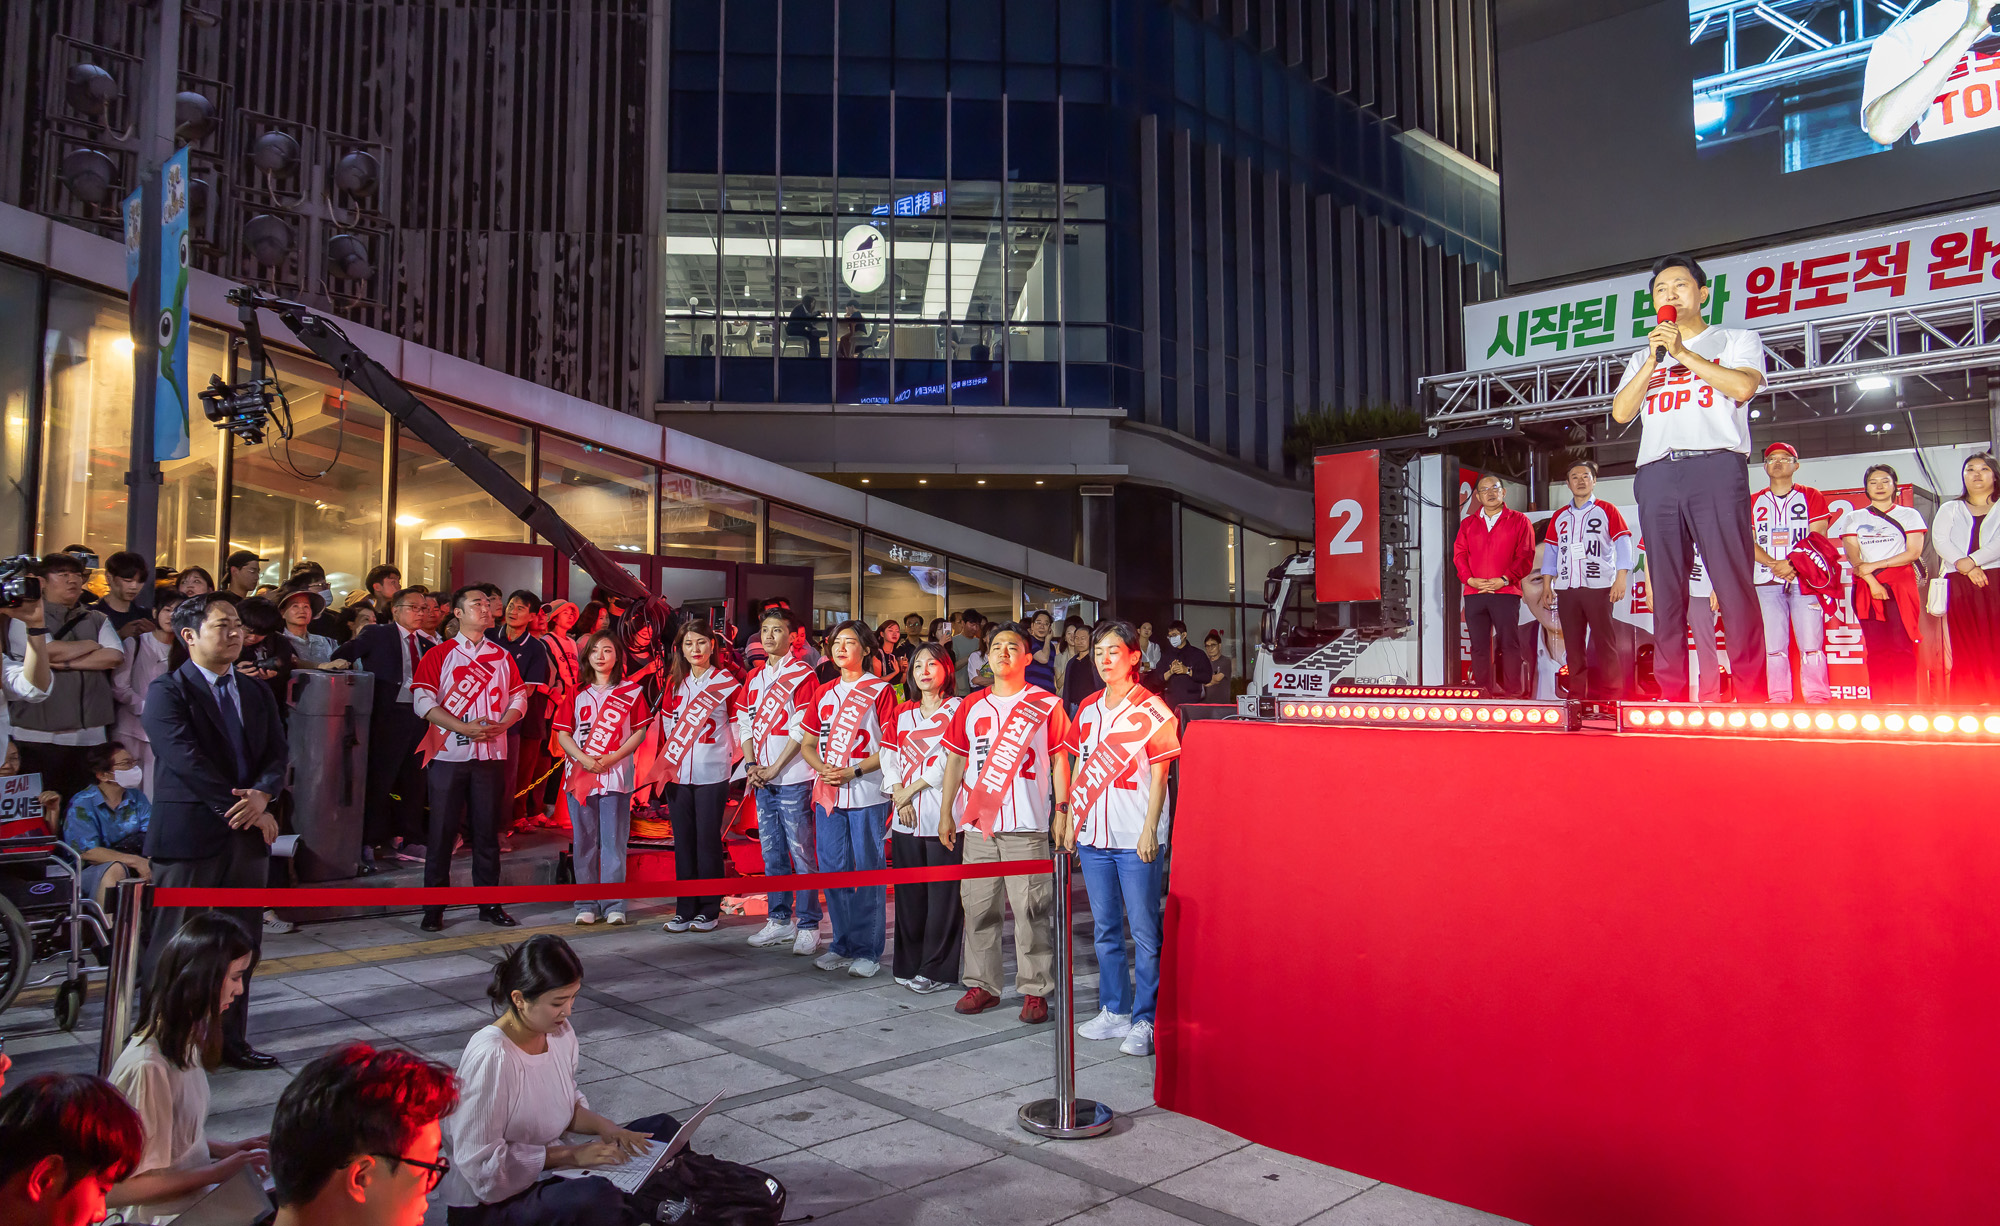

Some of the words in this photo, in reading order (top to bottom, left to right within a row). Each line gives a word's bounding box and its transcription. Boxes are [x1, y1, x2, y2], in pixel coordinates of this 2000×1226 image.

[846, 257, 882, 270] BERRY
[852, 250, 875, 260] OAK
[1486, 293, 1618, 360] 시작된
[1745, 240, 1911, 320] 압도적
[1927, 226, 2000, 291] 완
[1646, 389, 1691, 415] TOP
[1697, 385, 1714, 408] 3
[1329, 498, 1363, 556] 2
[1559, 521, 1568, 535] 2
[1757, 506, 1768, 521] 2
[1790, 503, 1807, 546] 오세
[1828, 499, 1854, 538] 2
[1586, 518, 1602, 578] 오세훈
[1830, 685, 1871, 700] 국민의
[664, 702, 708, 765] 강나연
[698, 717, 717, 744] 2
[851, 728, 871, 759] 2
[908, 713, 951, 755] 2
[1104, 712, 1153, 762] 2
[981, 716, 1034, 795] 최종부
[1019, 746, 1037, 780] 2
[4, 775, 29, 795] 역시!
[1071, 758, 1108, 822] 주수
[1, 796, 42, 820] 오세훈
